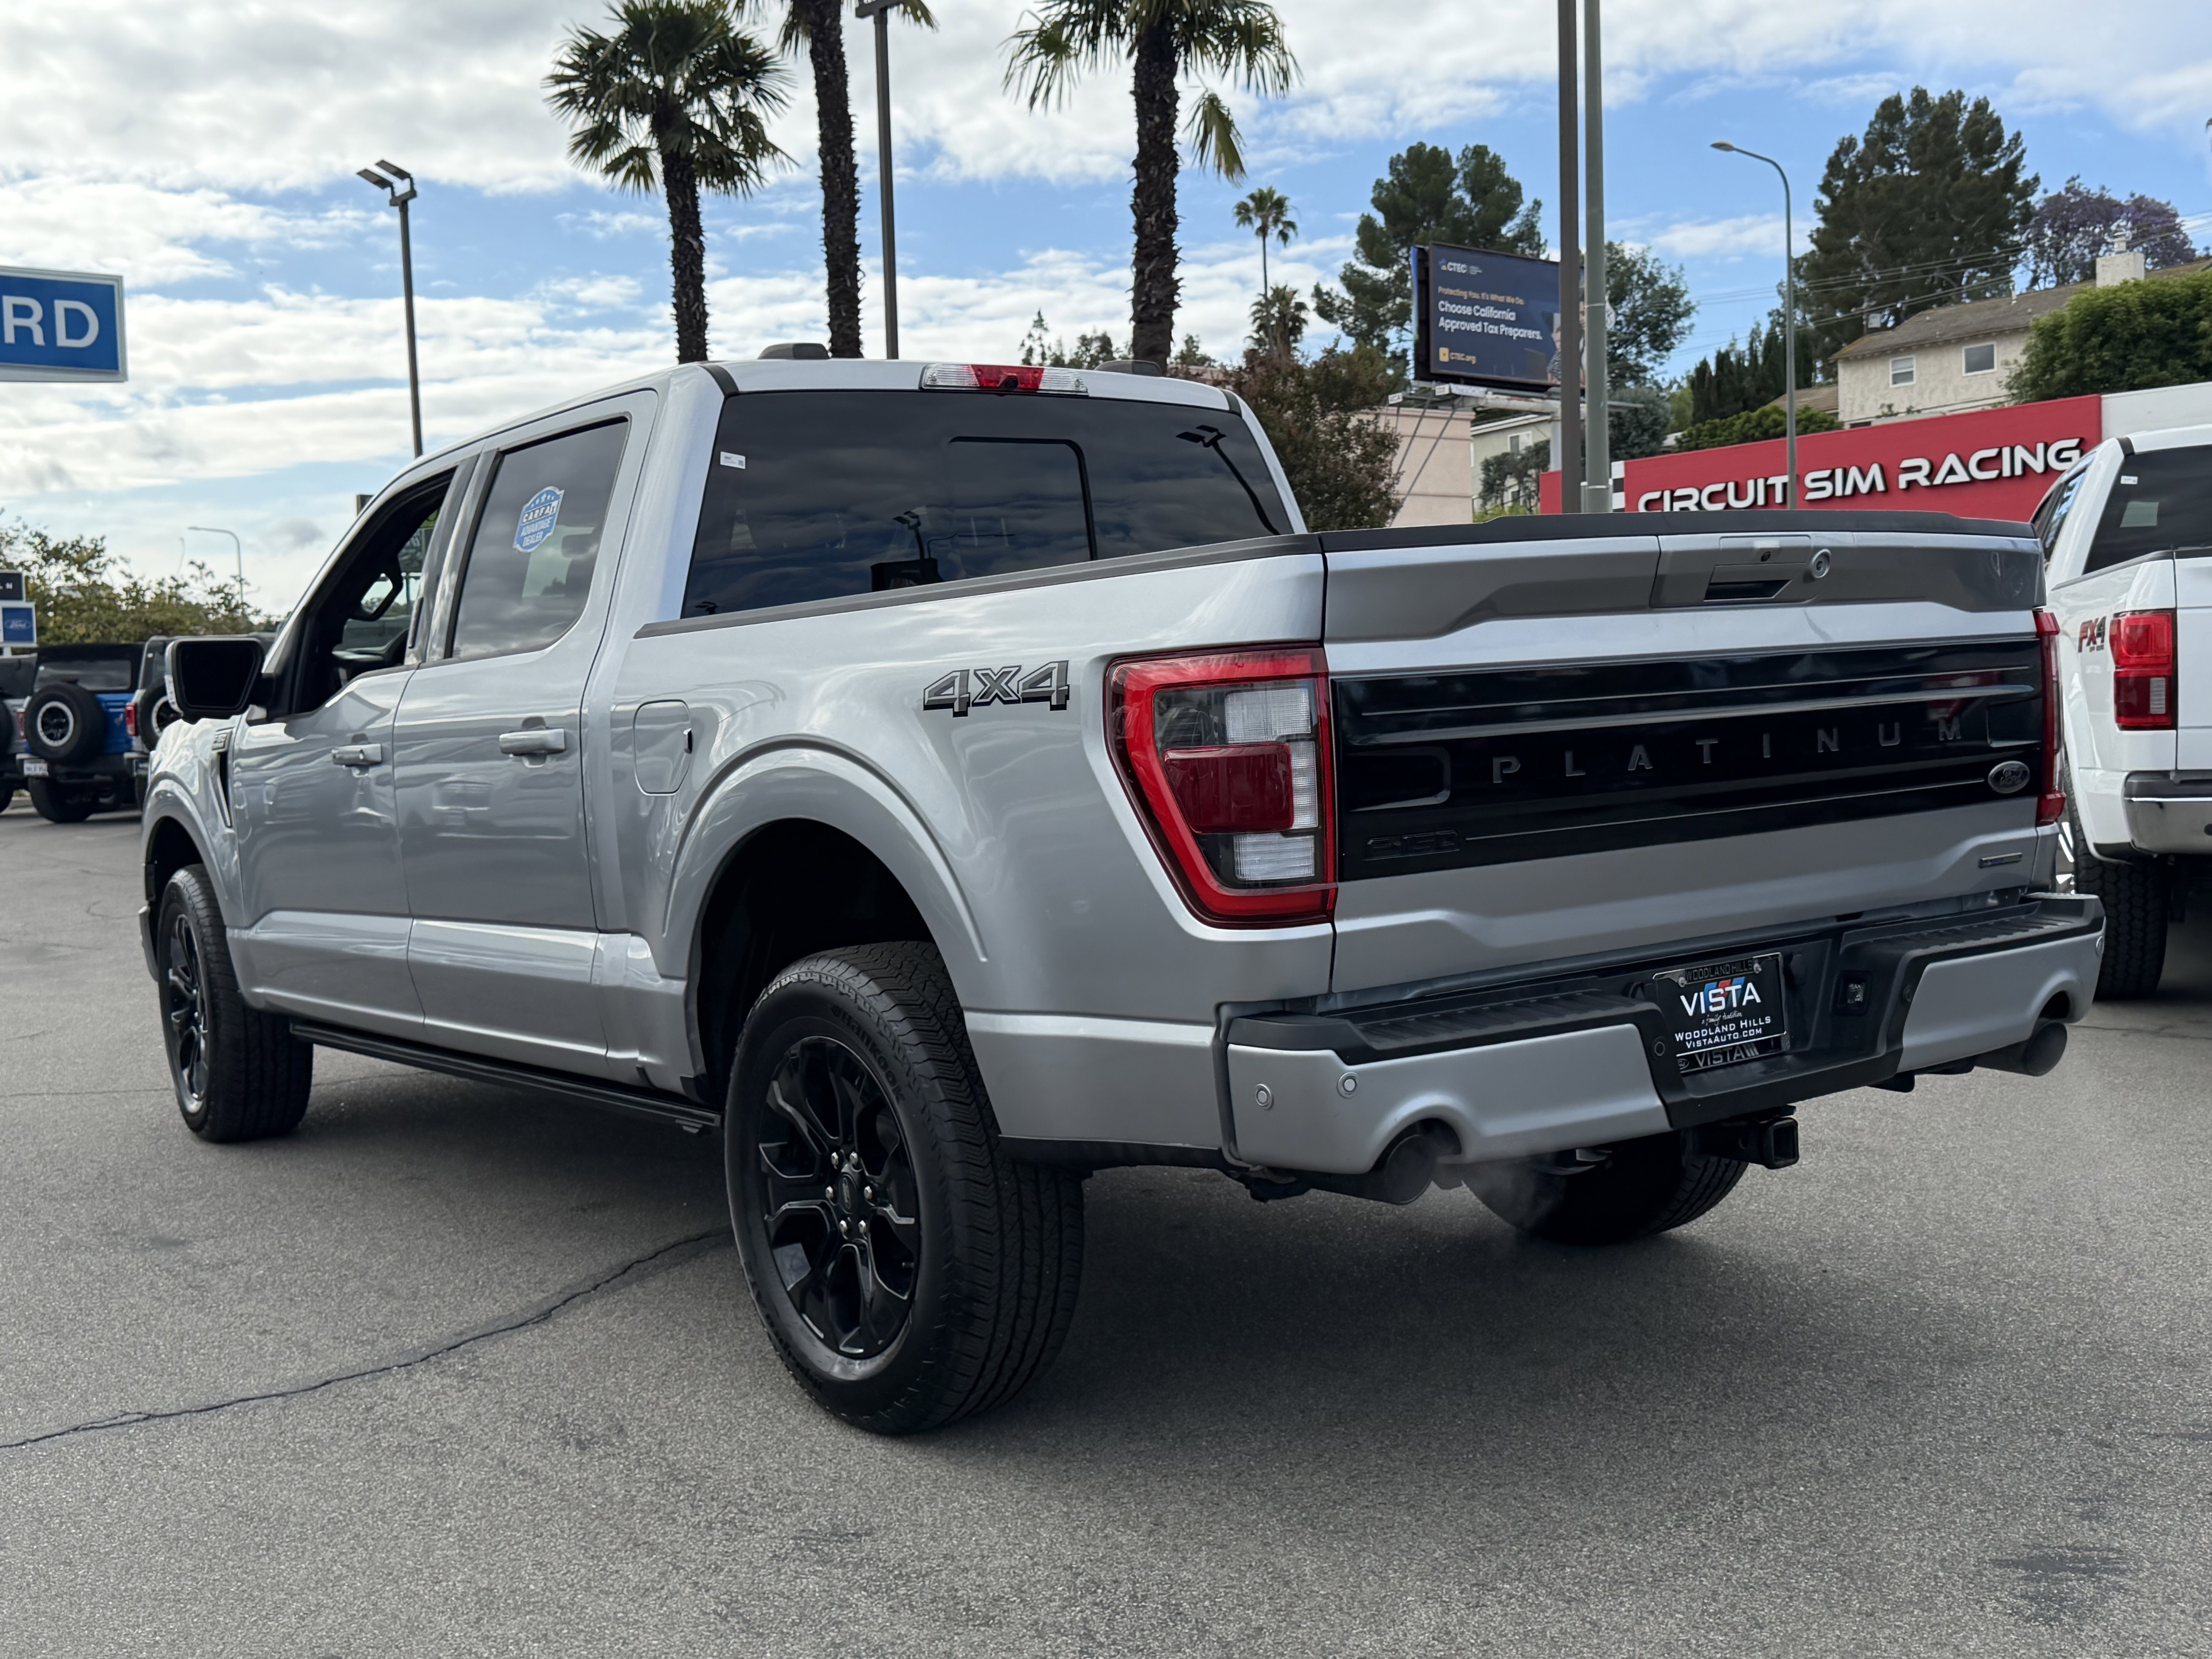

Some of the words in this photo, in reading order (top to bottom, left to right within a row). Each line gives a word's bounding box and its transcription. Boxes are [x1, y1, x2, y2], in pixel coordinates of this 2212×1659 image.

[1447, 262, 1467, 273] CTEC
[1438, 301, 1472, 315] Choose
[1473, 305, 1516, 321] California
[1439, 316, 1482, 332] Approved
[1483, 322, 1498, 334] Tax
[1500, 325, 1543, 340] Preparers.
[1638, 474, 1789, 512] CIRCUIT
[1804, 463, 1887, 501] SIM
[1898, 438, 2083, 489] RACING
[2078, 616, 2107, 653] FX4
[924, 660, 1070, 718] 4X4
[1493, 716, 1961, 783] PLATINUM
[1685, 963, 1730, 981] WOODLAND
[1731, 960, 1753, 973] HILLS
[1680, 982, 1762, 1016] VISTA
[1695, 1044, 1745, 1068] VISTA
